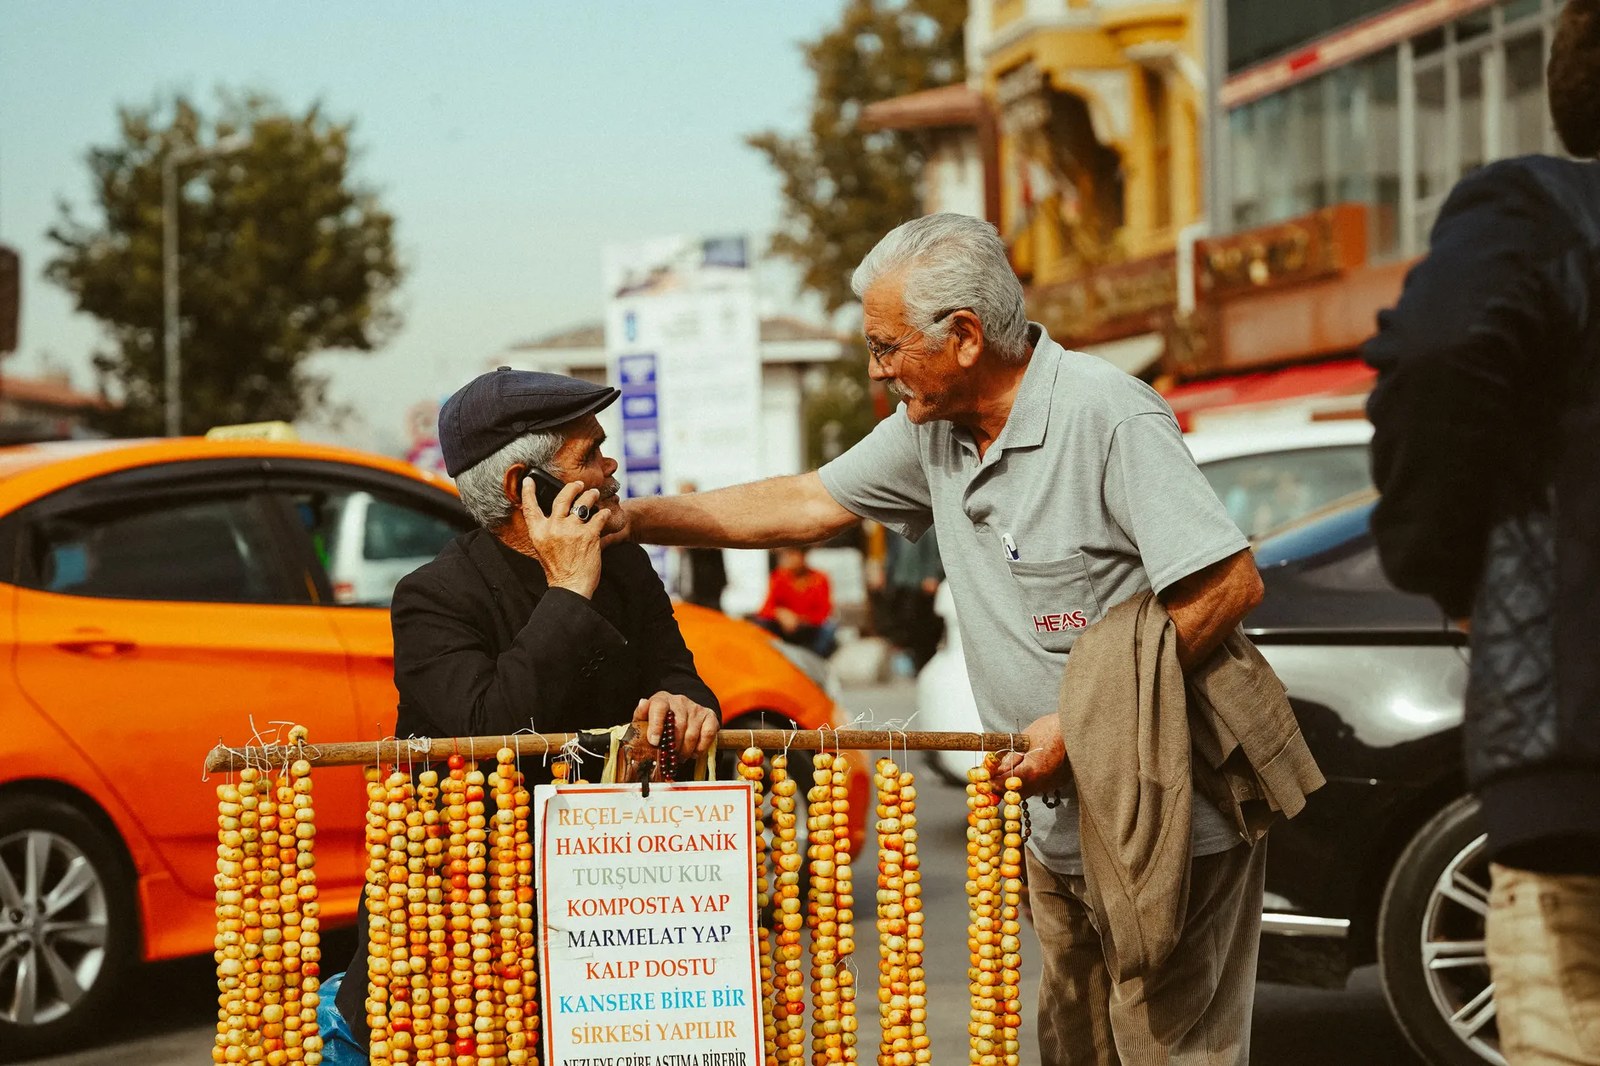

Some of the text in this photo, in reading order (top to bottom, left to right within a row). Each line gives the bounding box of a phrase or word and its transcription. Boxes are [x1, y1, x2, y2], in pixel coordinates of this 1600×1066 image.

[1032, 610, 1087, 632] HEAS
[556, 829, 738, 855] HAKİKİ ORGANİK
[573, 864, 722, 889] TURŞUNU KUR
[567, 894, 730, 917] KOMPOSTA YAP
[567, 925, 732, 948] MARMELAT YAP
[586, 958, 717, 980] KALP DOSTU
[560, 985, 746, 1014] KANSERE BİRE BİR
[571, 1020, 737, 1045] SİRKESİ YAPILIR
